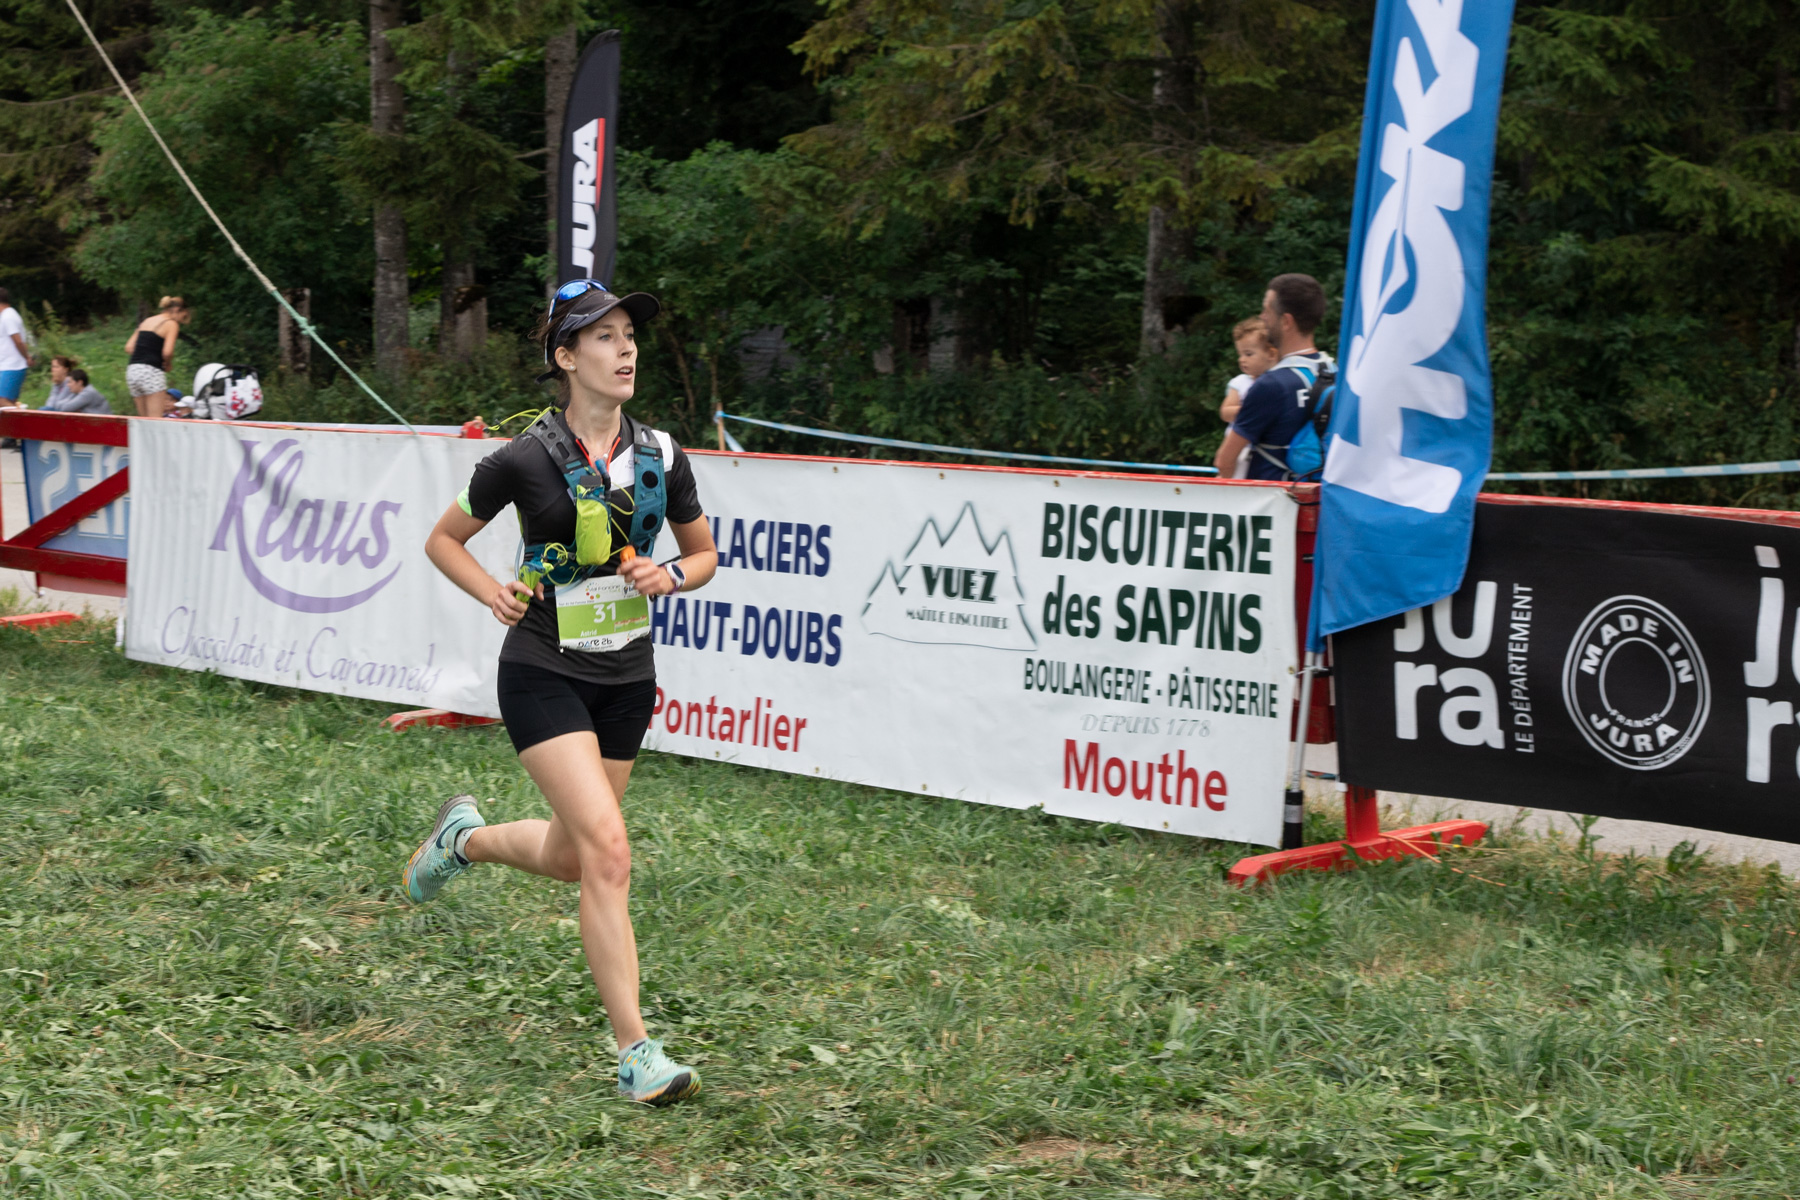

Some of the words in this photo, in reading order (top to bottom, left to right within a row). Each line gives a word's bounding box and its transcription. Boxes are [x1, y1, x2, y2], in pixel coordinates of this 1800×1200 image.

[571, 118, 599, 279] JURA
[208, 438, 402, 606] Klaus
[706, 515, 831, 577] LACIERS
[1041, 502, 1273, 575] BISCUITERIE
[593, 601, 617, 623] 31
[920, 564, 998, 604] VUEZ
[1042, 575, 1101, 639] des
[1115, 584, 1263, 654] SAPINS
[1743, 545, 1800, 688] j
[161, 605, 266, 669] Chocolats
[274, 640, 298, 673] et
[306, 626, 443, 693] Caramels
[580, 629, 598, 638] Astrid
[652, 596, 843, 667] HAUT-DOUBS
[1508, 583, 1533, 727] DÉPARTEMENT
[1580, 614, 1660, 676] MADE
[1666, 642, 1696, 684] IN
[647, 686, 807, 752] Pontarlier
[1024, 658, 1151, 704] BOULANGERIE
[1168, 666, 1278, 718] PÂTISSERIE
[1609, 709, 1661, 729] FRANCE
[1080, 713, 1162, 736] DEPUIS
[1166, 718, 1211, 738] 1778
[1515, 730, 1535, 753] LE
[1589, 713, 1680, 752] JURA
[1746, 697, 1800, 784] r
[1063, 738, 1229, 812] Mouthe
